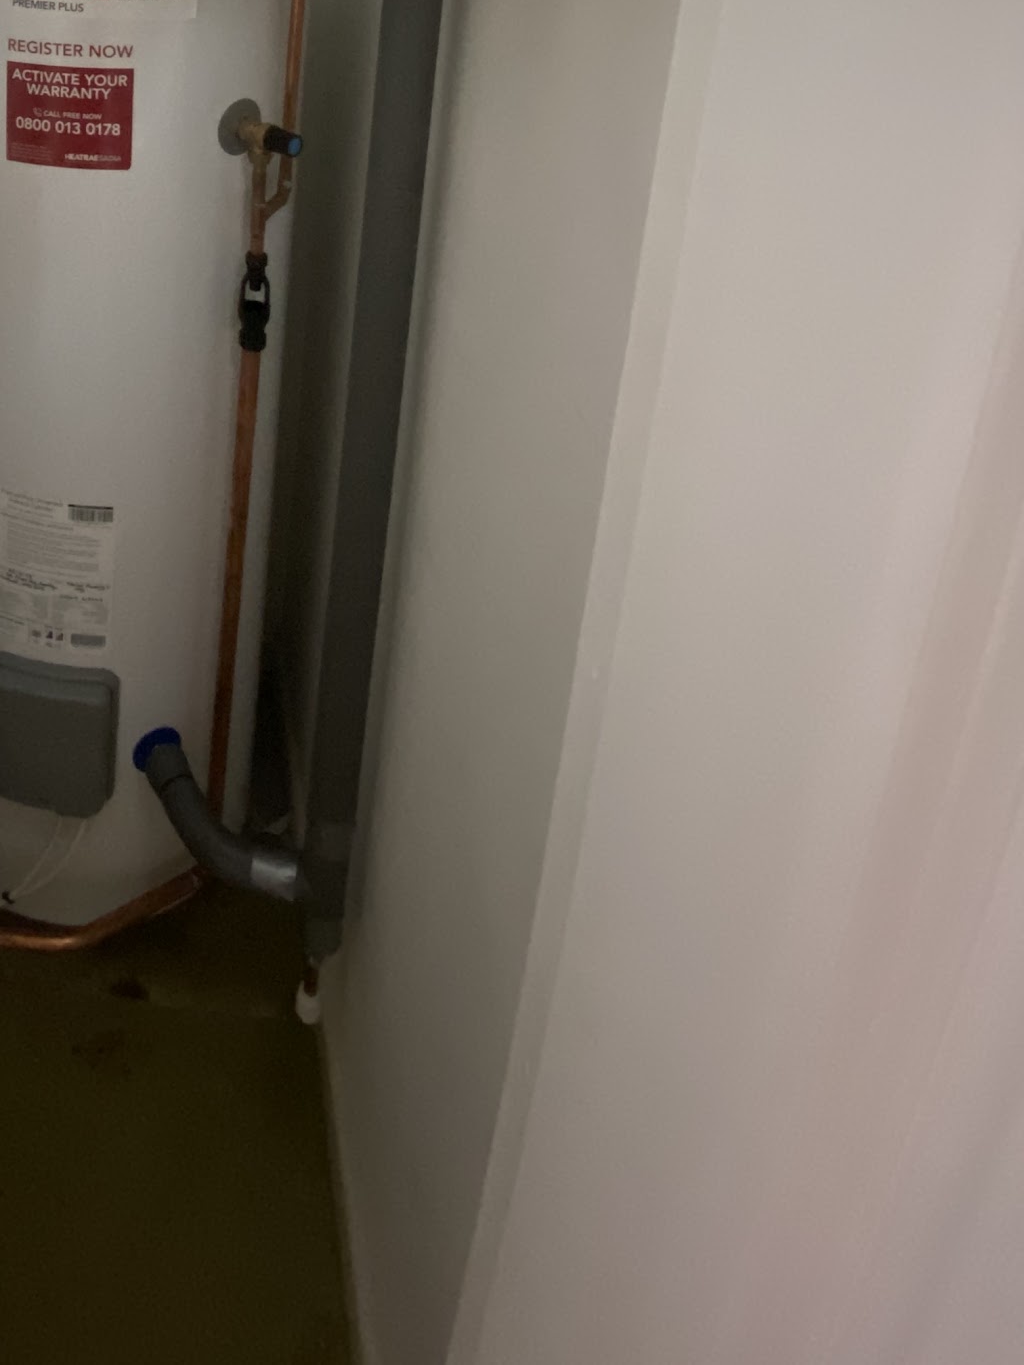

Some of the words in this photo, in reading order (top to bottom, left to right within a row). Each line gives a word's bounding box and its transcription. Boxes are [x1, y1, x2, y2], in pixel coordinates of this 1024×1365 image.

[58, 2, 84, 12] PLUS
[7, 38, 83, 57] REGISTER
[88, 44, 134, 58] NOW
[12, 68, 80, 86] ACTIVATE
[84, 74, 128, 87] YOUR
[26, 82, 111, 100] WARRANTY
[43, 110, 61, 119] CALL
[63, 112, 80, 120] FREE
[82, 113, 102, 121] NOW
[15, 116, 51, 132] 0800
[55, 120, 81, 135] 013
[85, 122, 121, 137] 0178
